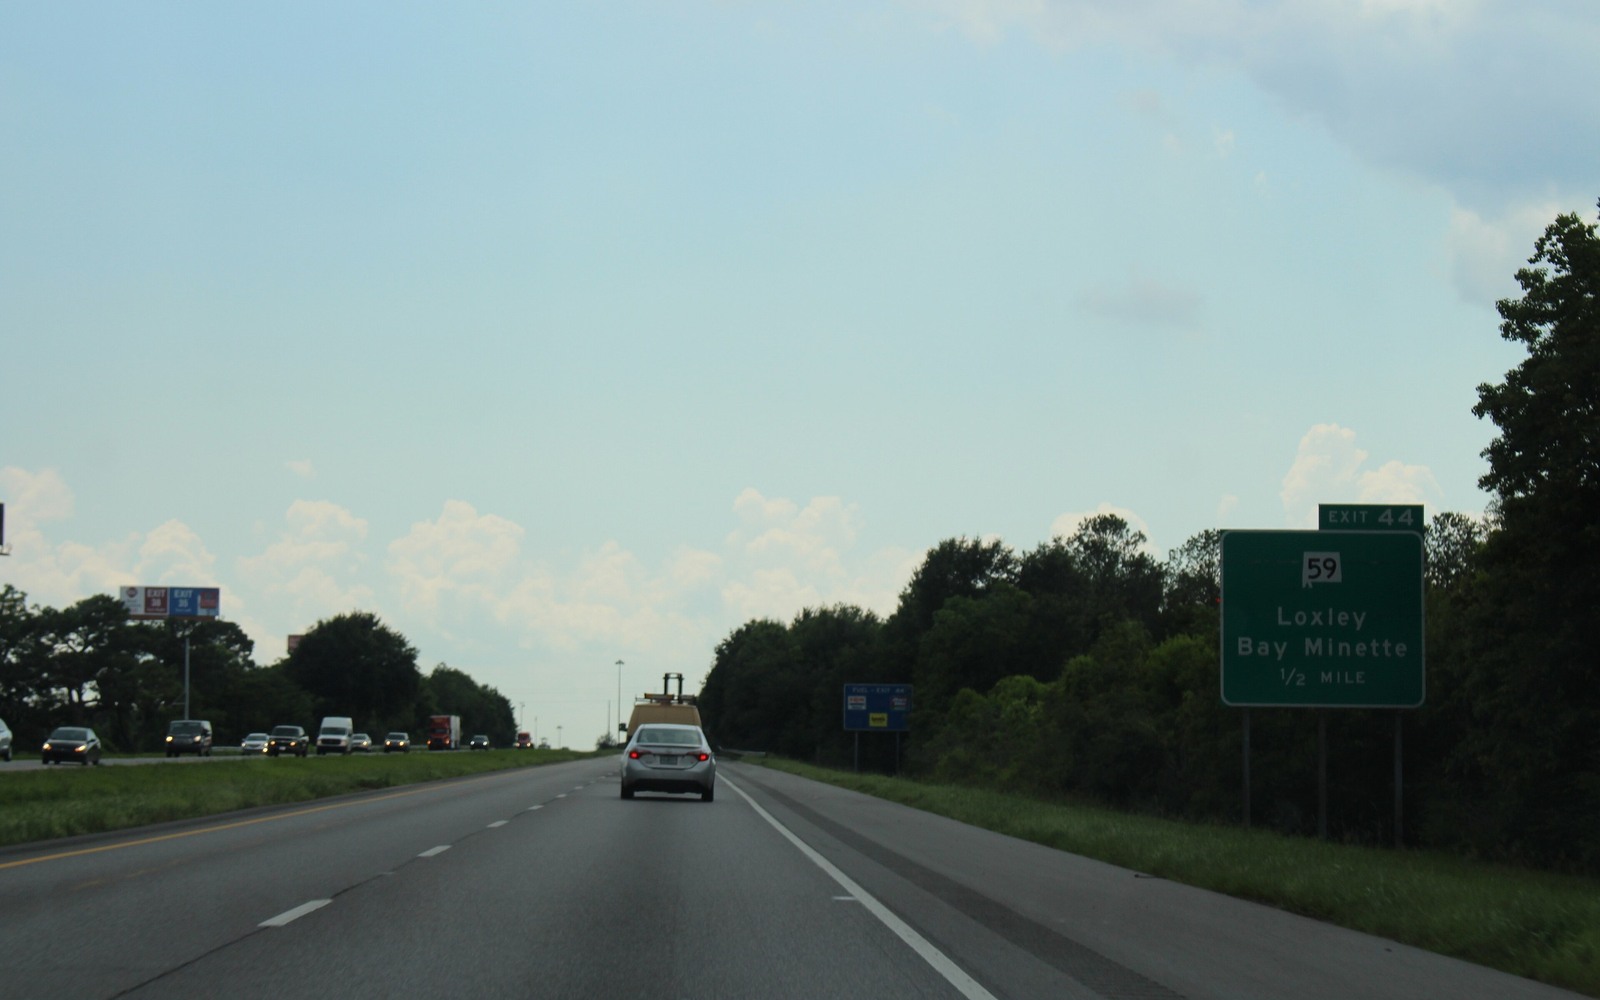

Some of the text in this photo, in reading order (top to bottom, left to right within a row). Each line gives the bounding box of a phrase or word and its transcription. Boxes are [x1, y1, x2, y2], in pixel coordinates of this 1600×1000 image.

[1328, 508, 1414, 526] EXIT 44
[1307, 558, 1337, 579] 59
[147, 589, 165, 598] EXIT
[174, 590, 192, 598] EXIT
[1277, 606, 1367, 631] Loxley
[1237, 637, 1408, 661] Bay Minette
[1321, 672, 1366, 684] MILE
